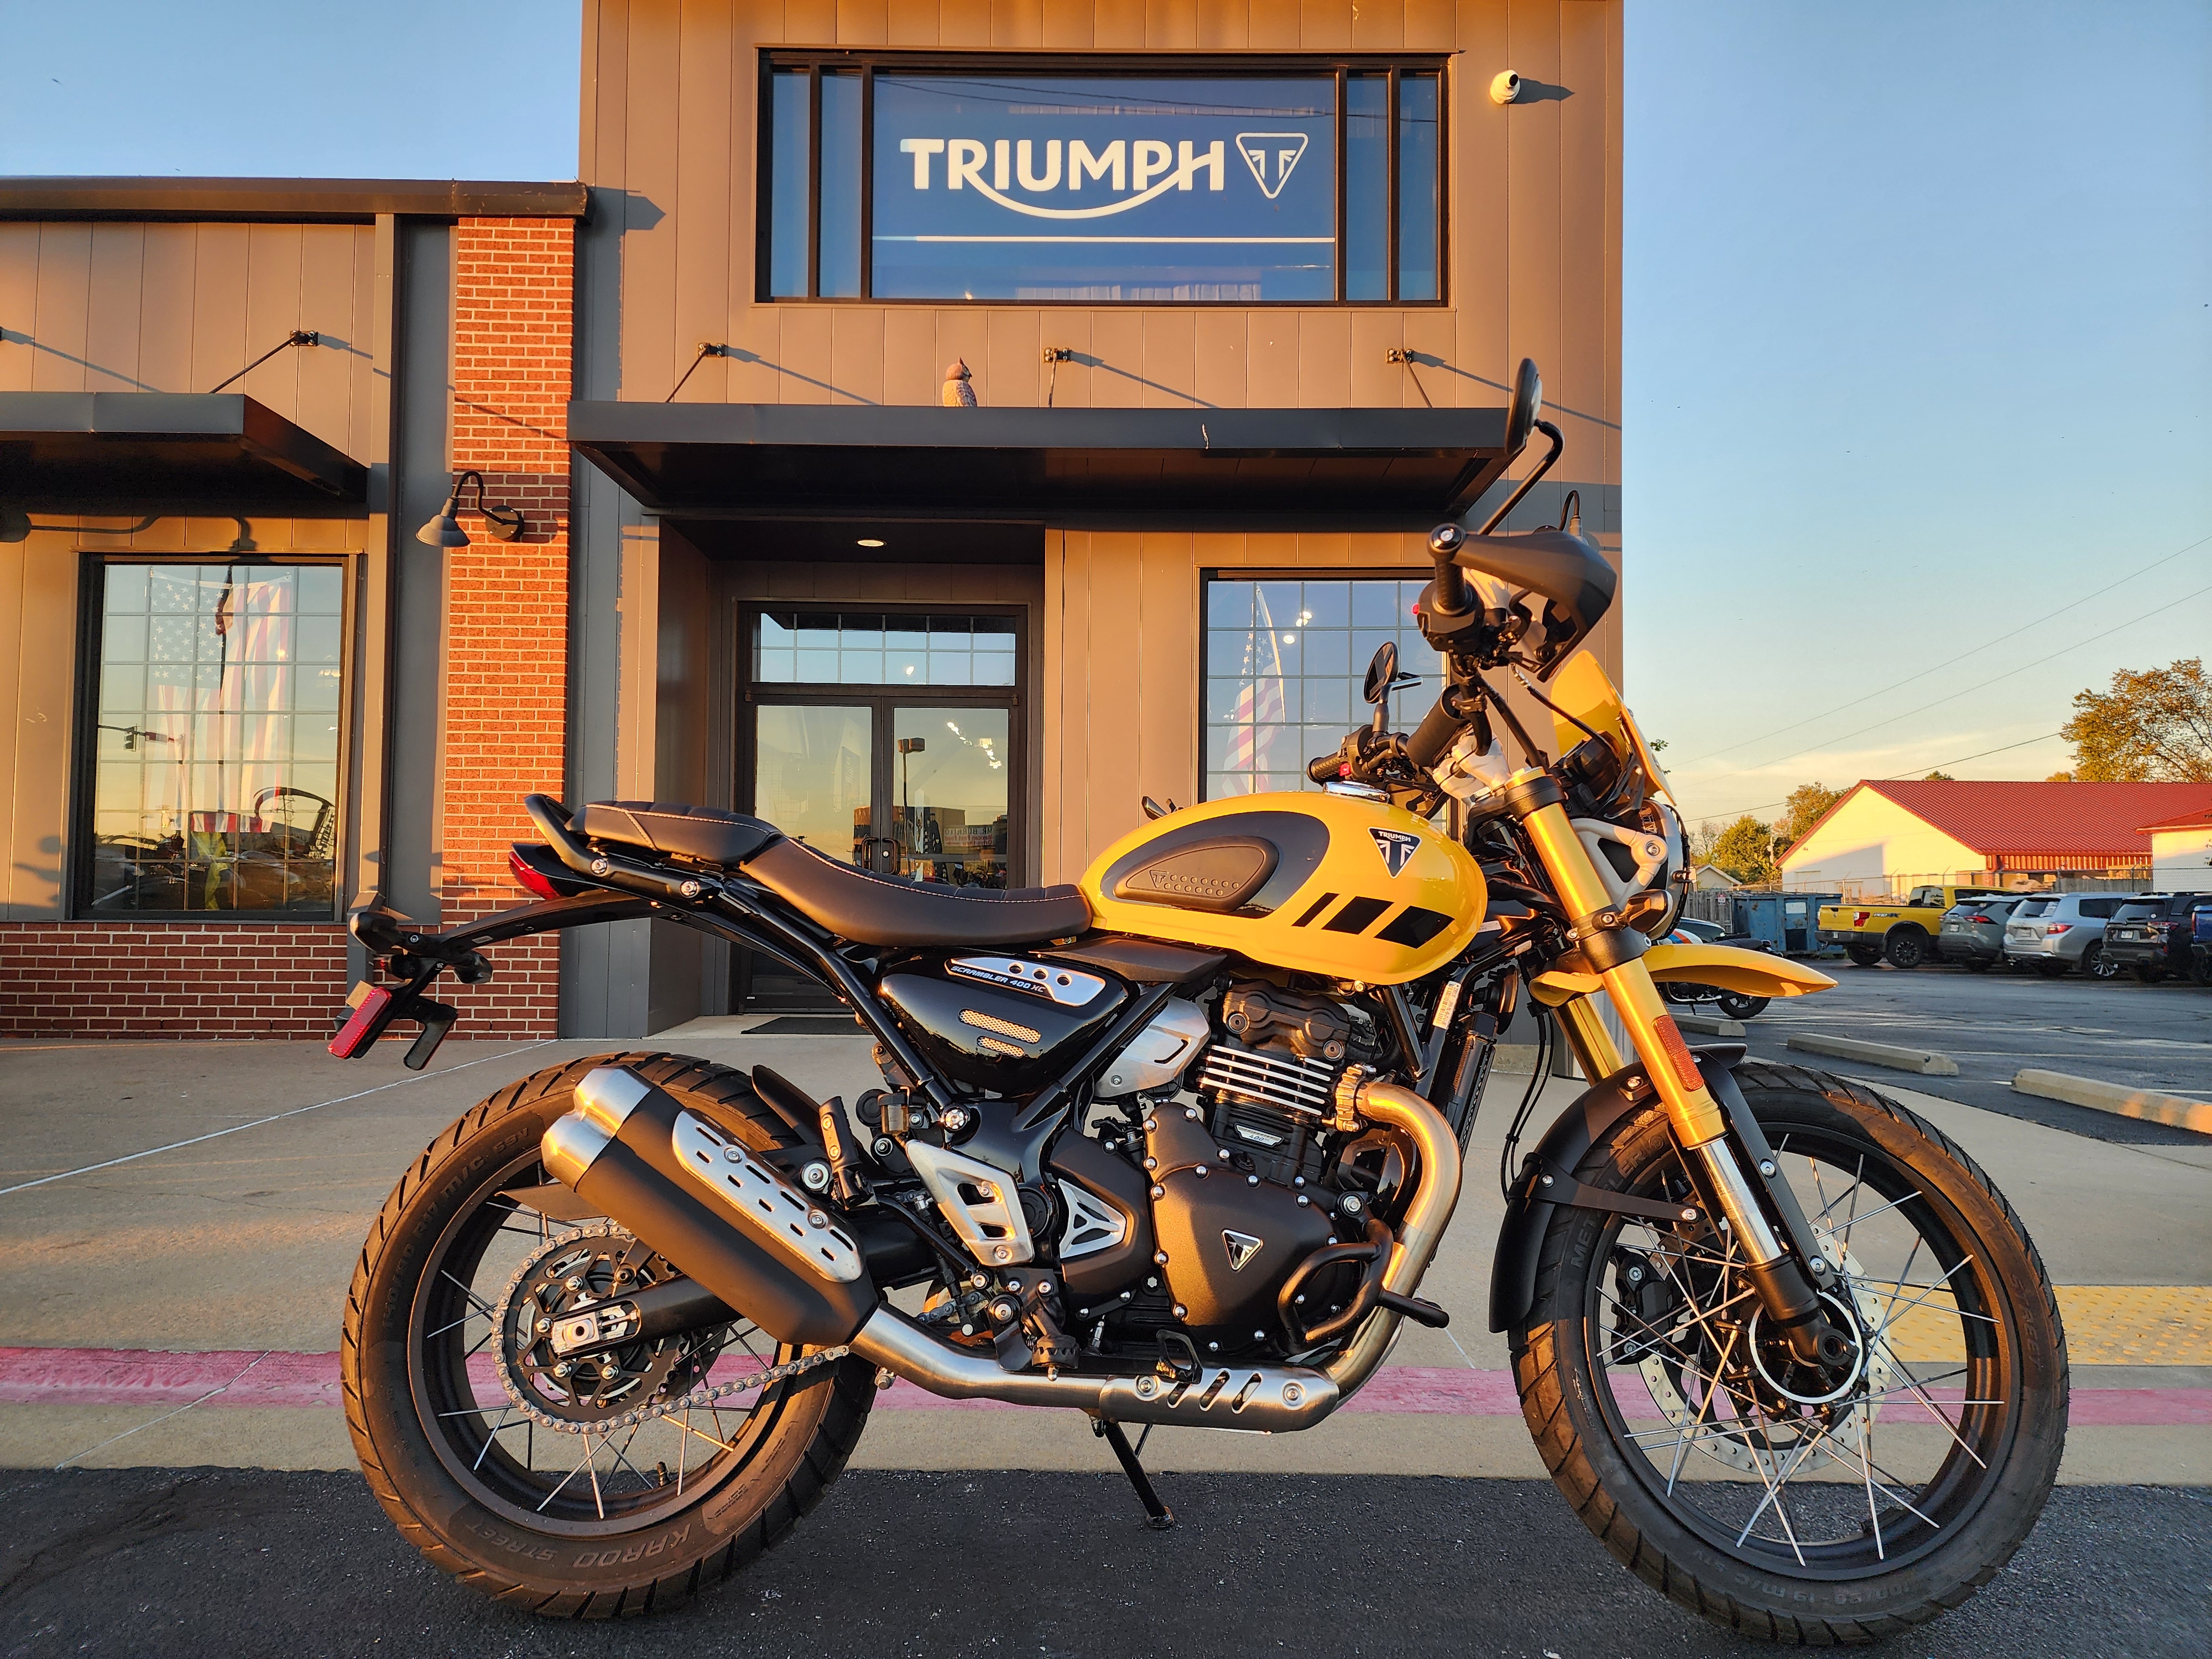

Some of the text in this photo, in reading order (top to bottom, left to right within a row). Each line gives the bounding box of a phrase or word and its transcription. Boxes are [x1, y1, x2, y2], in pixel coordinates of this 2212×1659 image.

[899, 138, 1224, 220] TRIUMPH
[1378, 831, 1411, 842] TRIUMPH
[950, 966, 1047, 993] SCRAMBLER 400 XC
[465, 1522, 691, 1568] KAROO STREET
